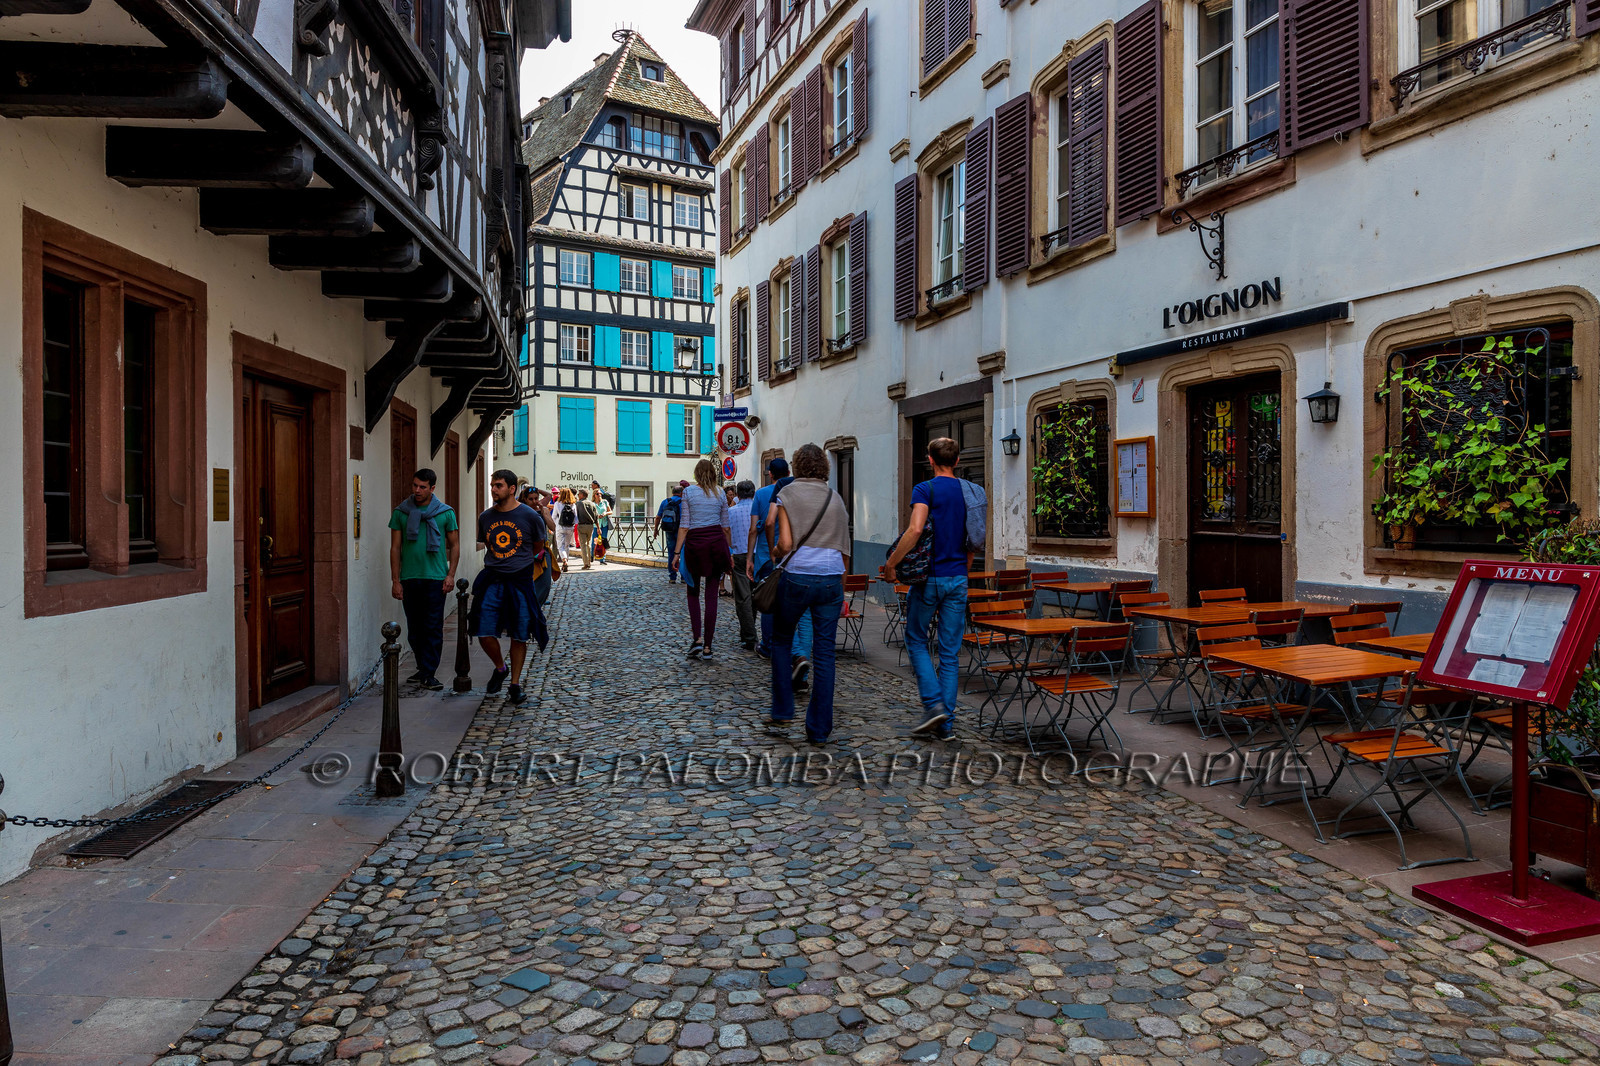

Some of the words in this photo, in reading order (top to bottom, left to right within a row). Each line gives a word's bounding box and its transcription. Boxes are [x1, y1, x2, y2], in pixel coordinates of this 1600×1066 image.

[1163, 276, 1281, 329] L'OIGNON
[1182, 327, 1246, 349] RESTAURANT
[728, 434, 734, 444] 8
[560, 470, 594, 481] Pavillon
[1493, 567, 1565, 582] MENU
